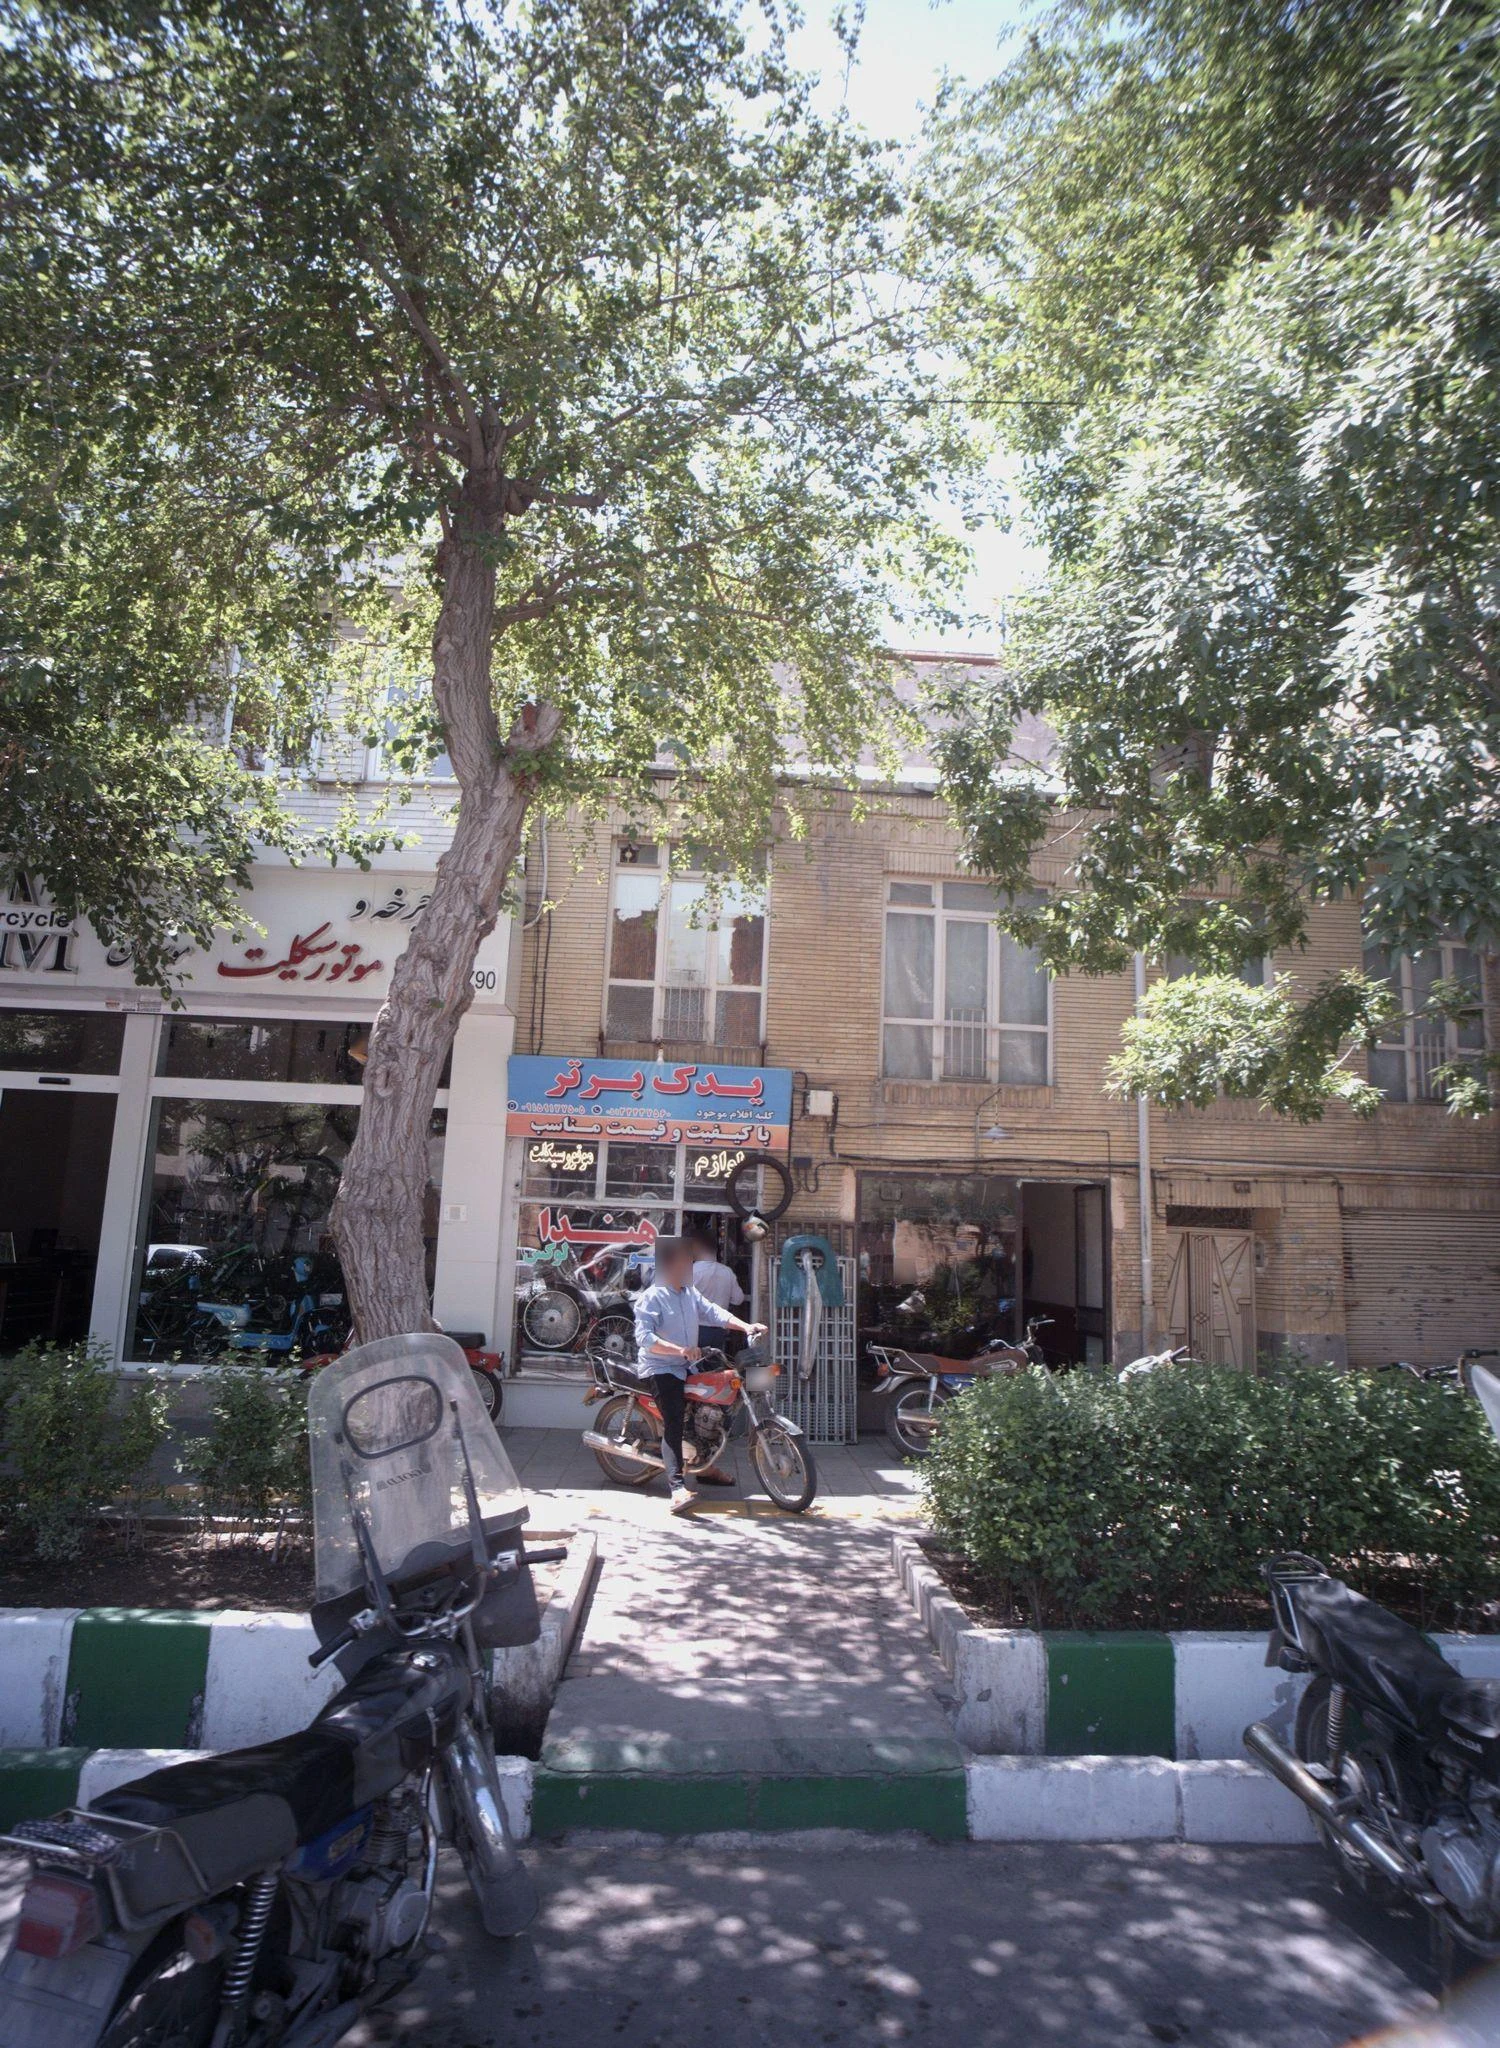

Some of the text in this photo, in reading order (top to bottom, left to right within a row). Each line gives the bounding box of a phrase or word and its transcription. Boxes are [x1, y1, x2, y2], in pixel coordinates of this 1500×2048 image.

[545, 1059, 764, 1106] یدک برتر
[696, 1109, 774, 1122] کلیه اقلام موجود
[530, 1116, 771, 1147] با کیفیت و قیمت مناسب
